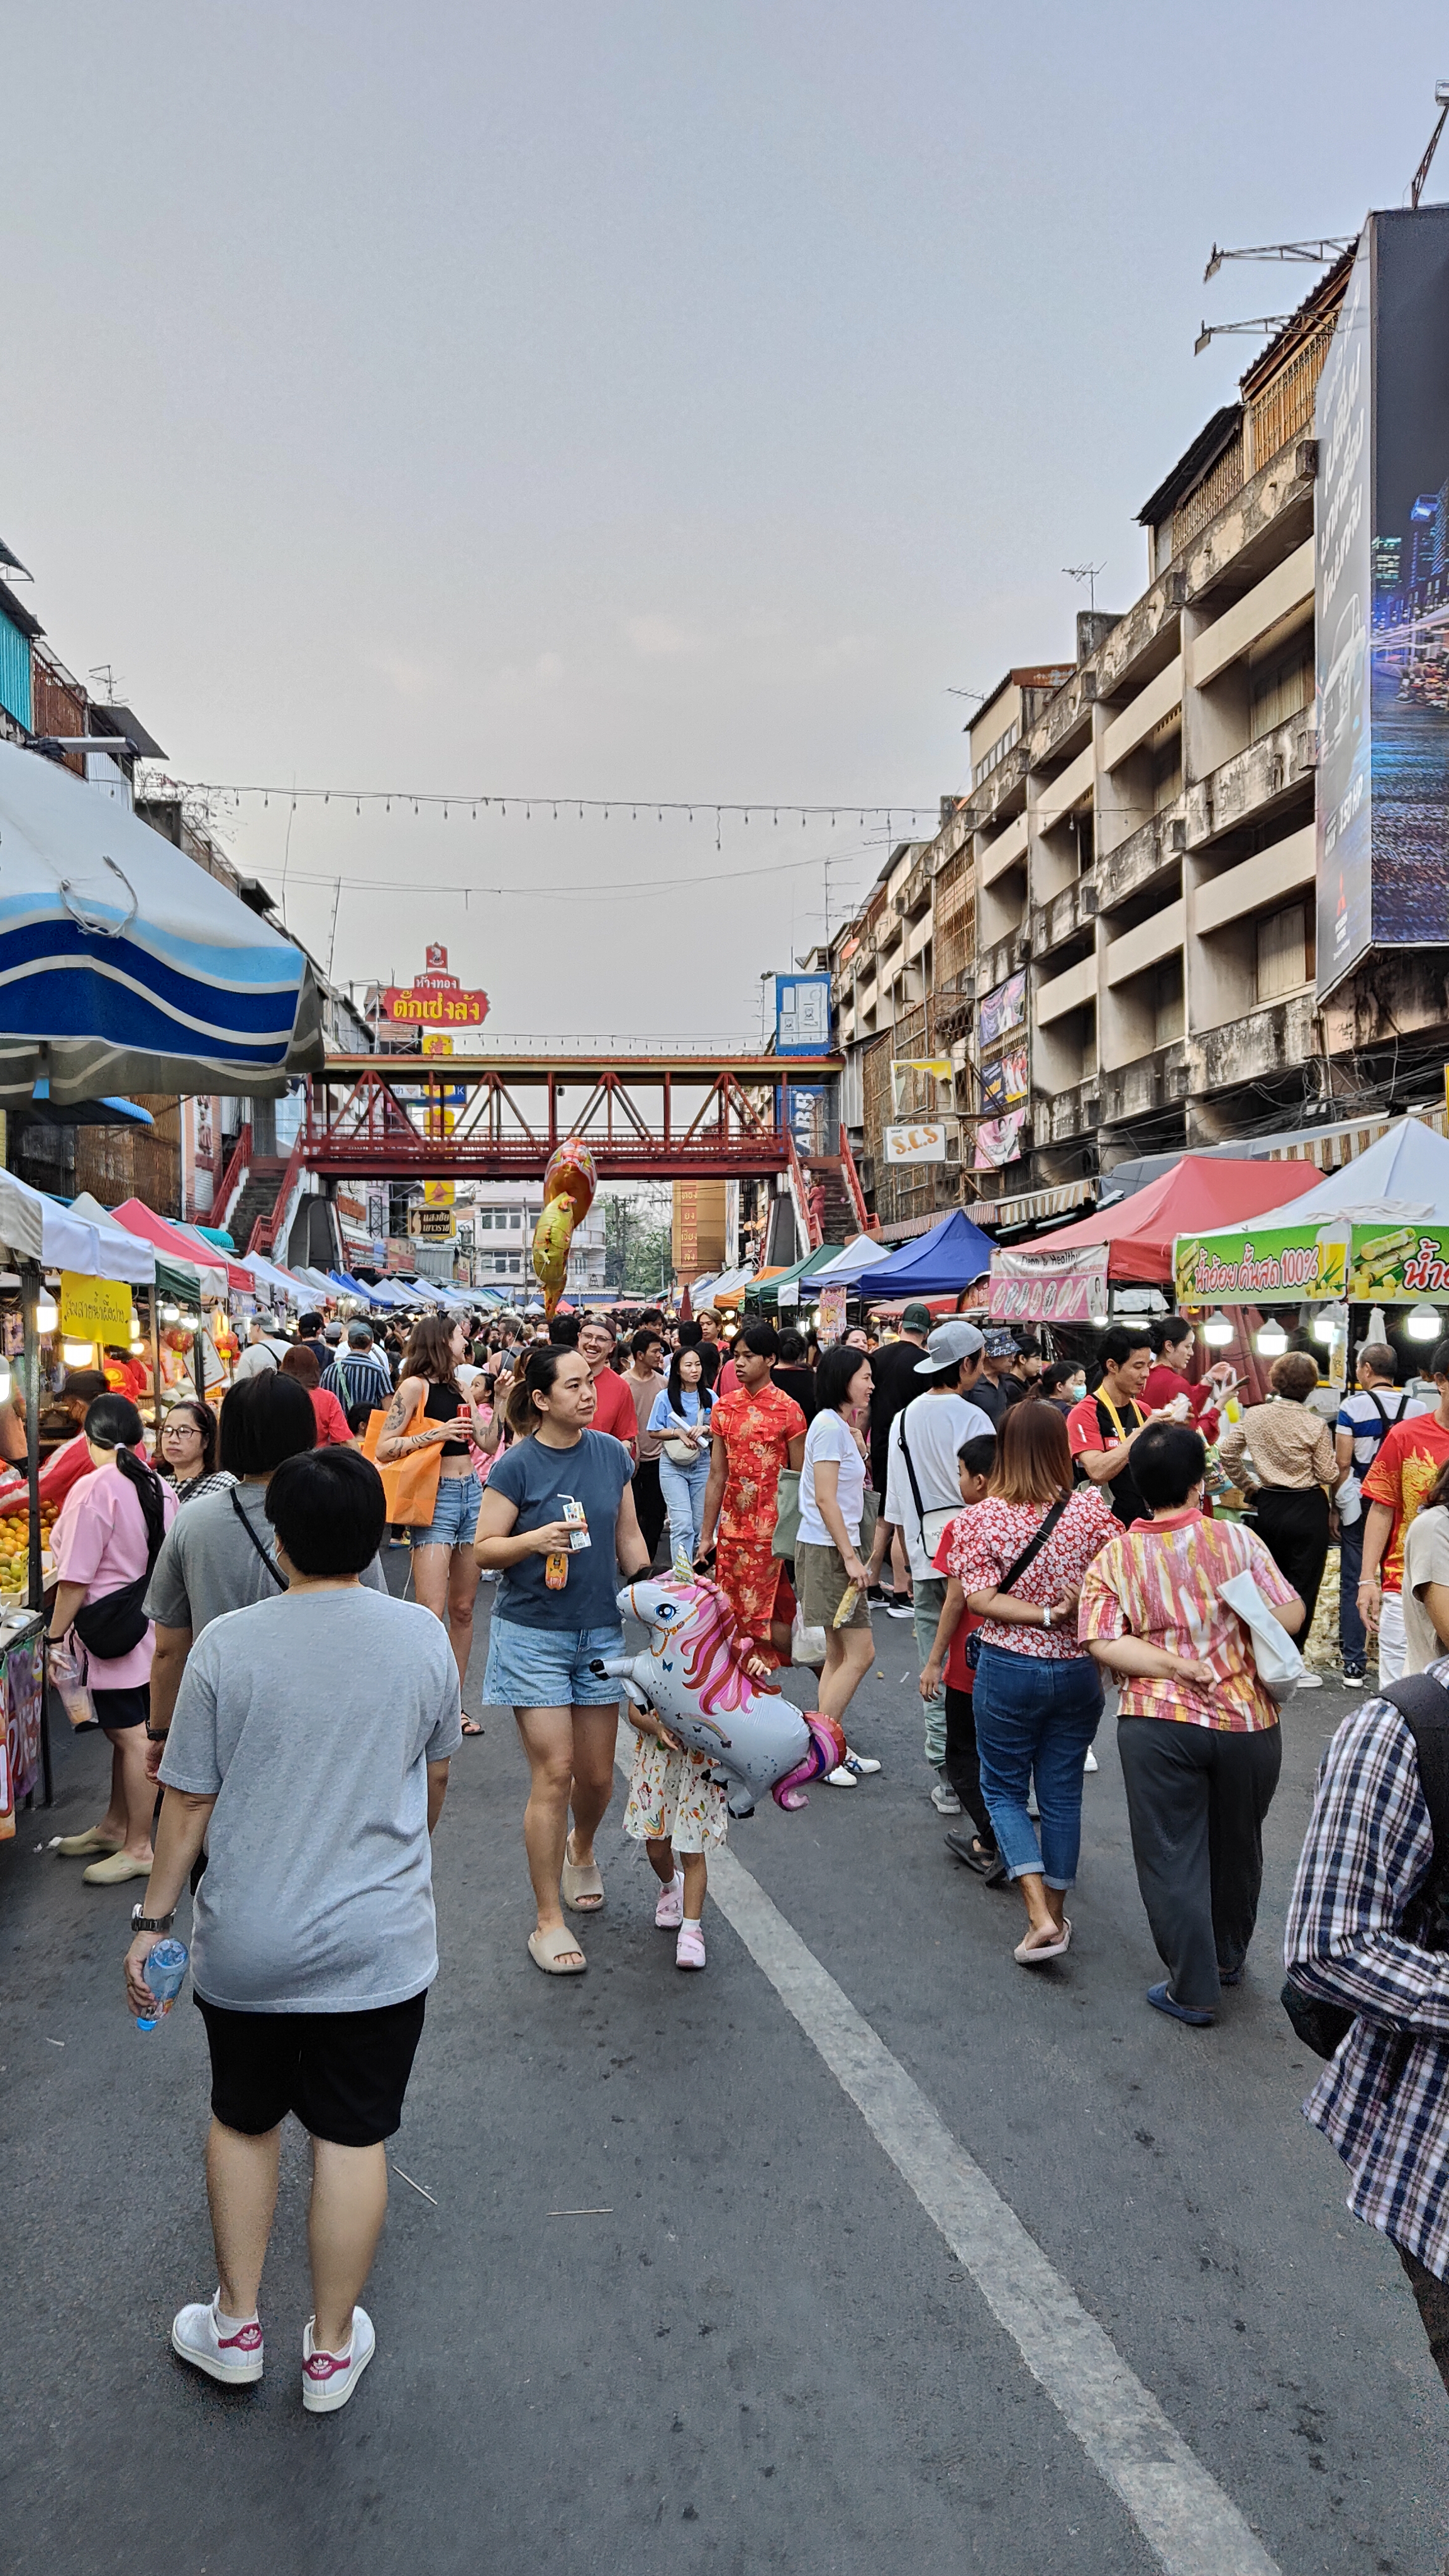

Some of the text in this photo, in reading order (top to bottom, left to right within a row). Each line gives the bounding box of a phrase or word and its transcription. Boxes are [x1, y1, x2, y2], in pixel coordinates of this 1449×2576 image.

[1352, 774, 1363, 816] HP
[416, 975, 457, 989] ห้างทอง
[423, 1212, 450, 1222] แสงชัย
[1195, 1241, 1319, 1292] น้ำอ้อย คั้นสด 100%
[1403, 1236, 1449, 1291] น้ำ
